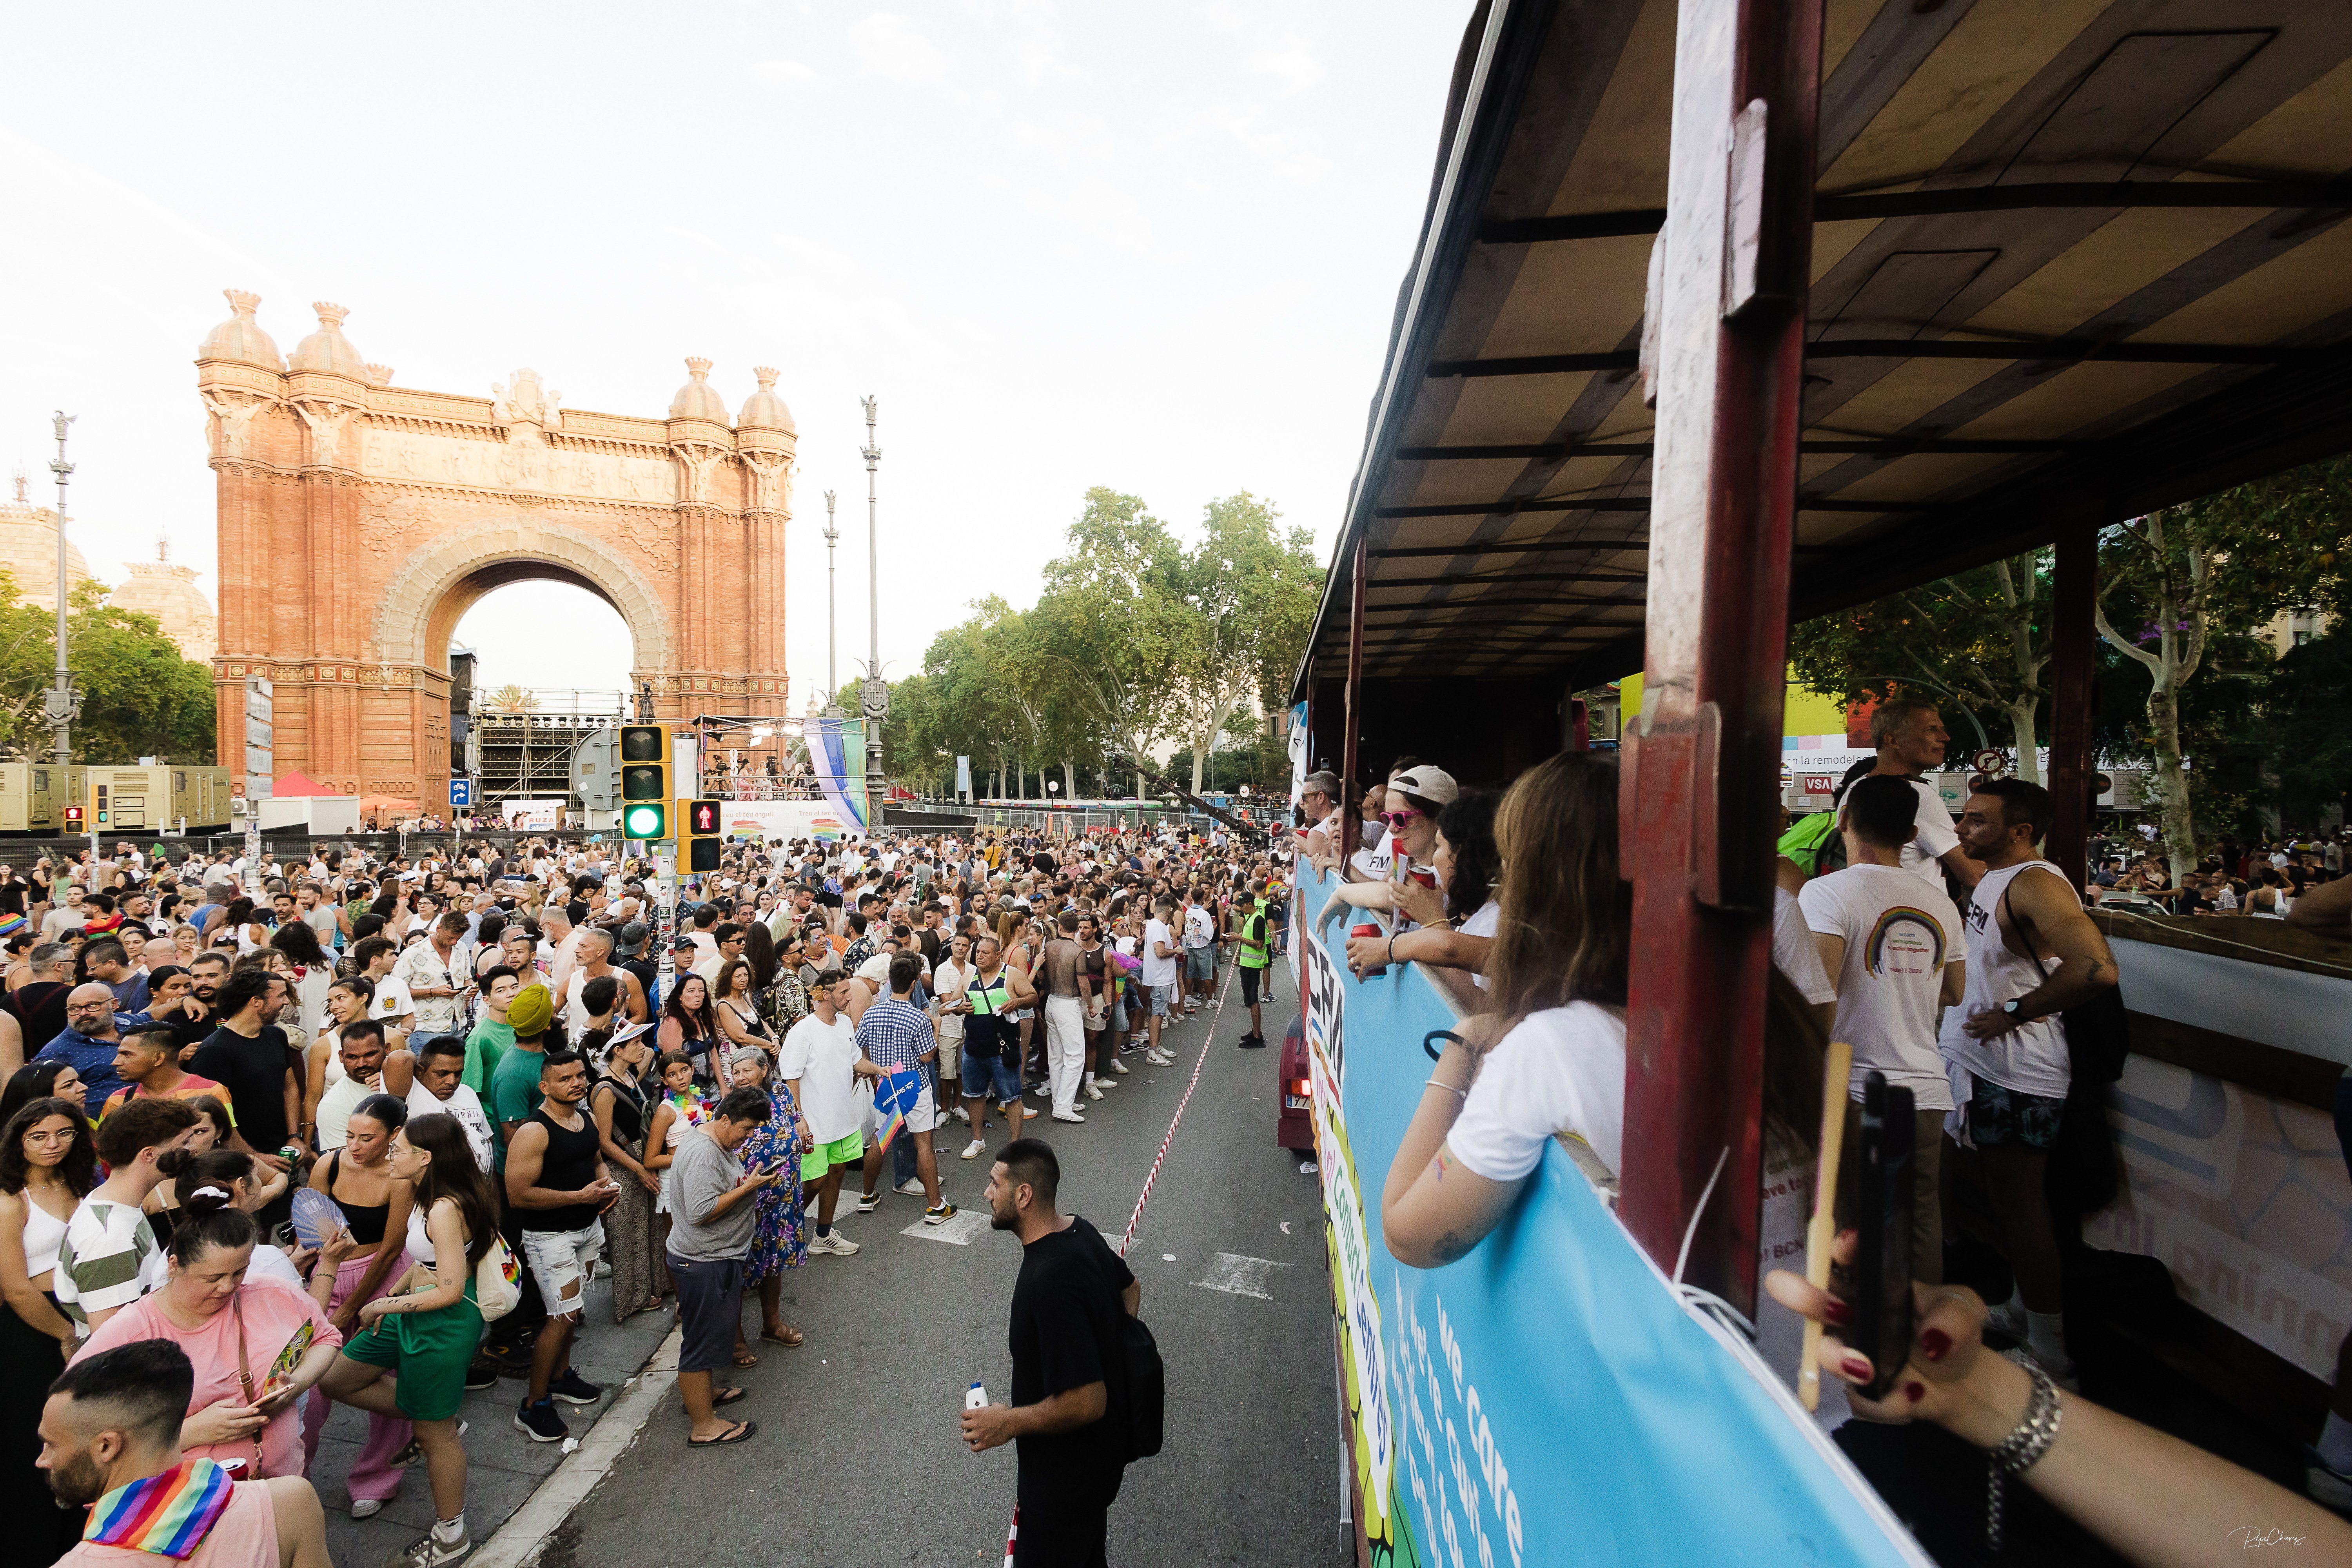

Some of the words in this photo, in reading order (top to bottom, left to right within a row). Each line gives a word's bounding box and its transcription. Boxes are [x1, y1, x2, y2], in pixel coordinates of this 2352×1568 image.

[1801, 756, 1810, 765] la
[1334, 1165, 1361, 1297] Contact
[1357, 1268, 1389, 1467] Centres
[1436, 1293, 1463, 1404] We
[1467, 1385, 1523, 1568] care
